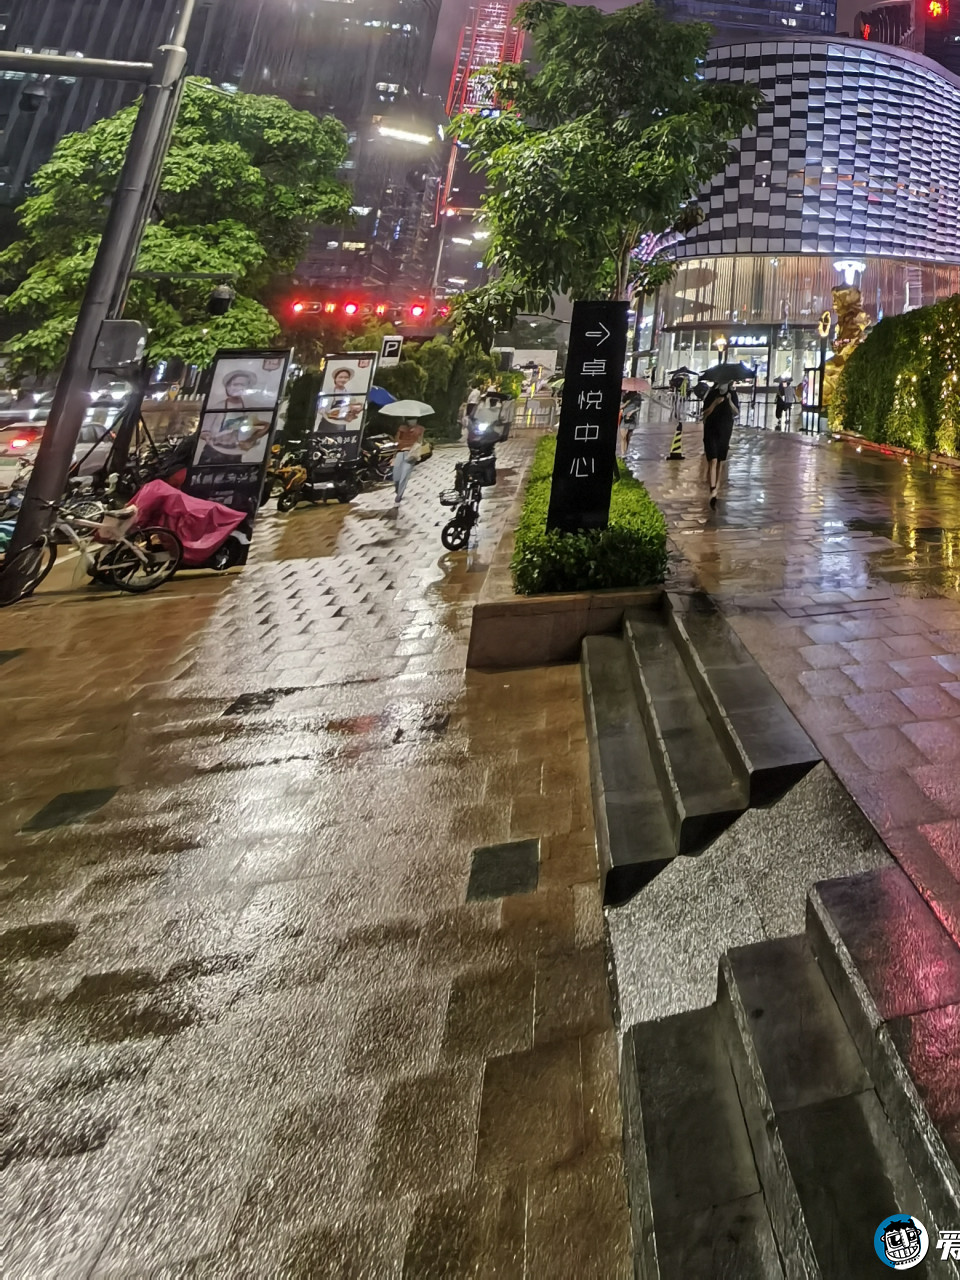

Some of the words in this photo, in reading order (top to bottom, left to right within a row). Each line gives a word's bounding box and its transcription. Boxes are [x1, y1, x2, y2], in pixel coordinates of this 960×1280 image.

[384, 342, 398, 356] P
[569, 359, 607, 477] 卓悦中心
